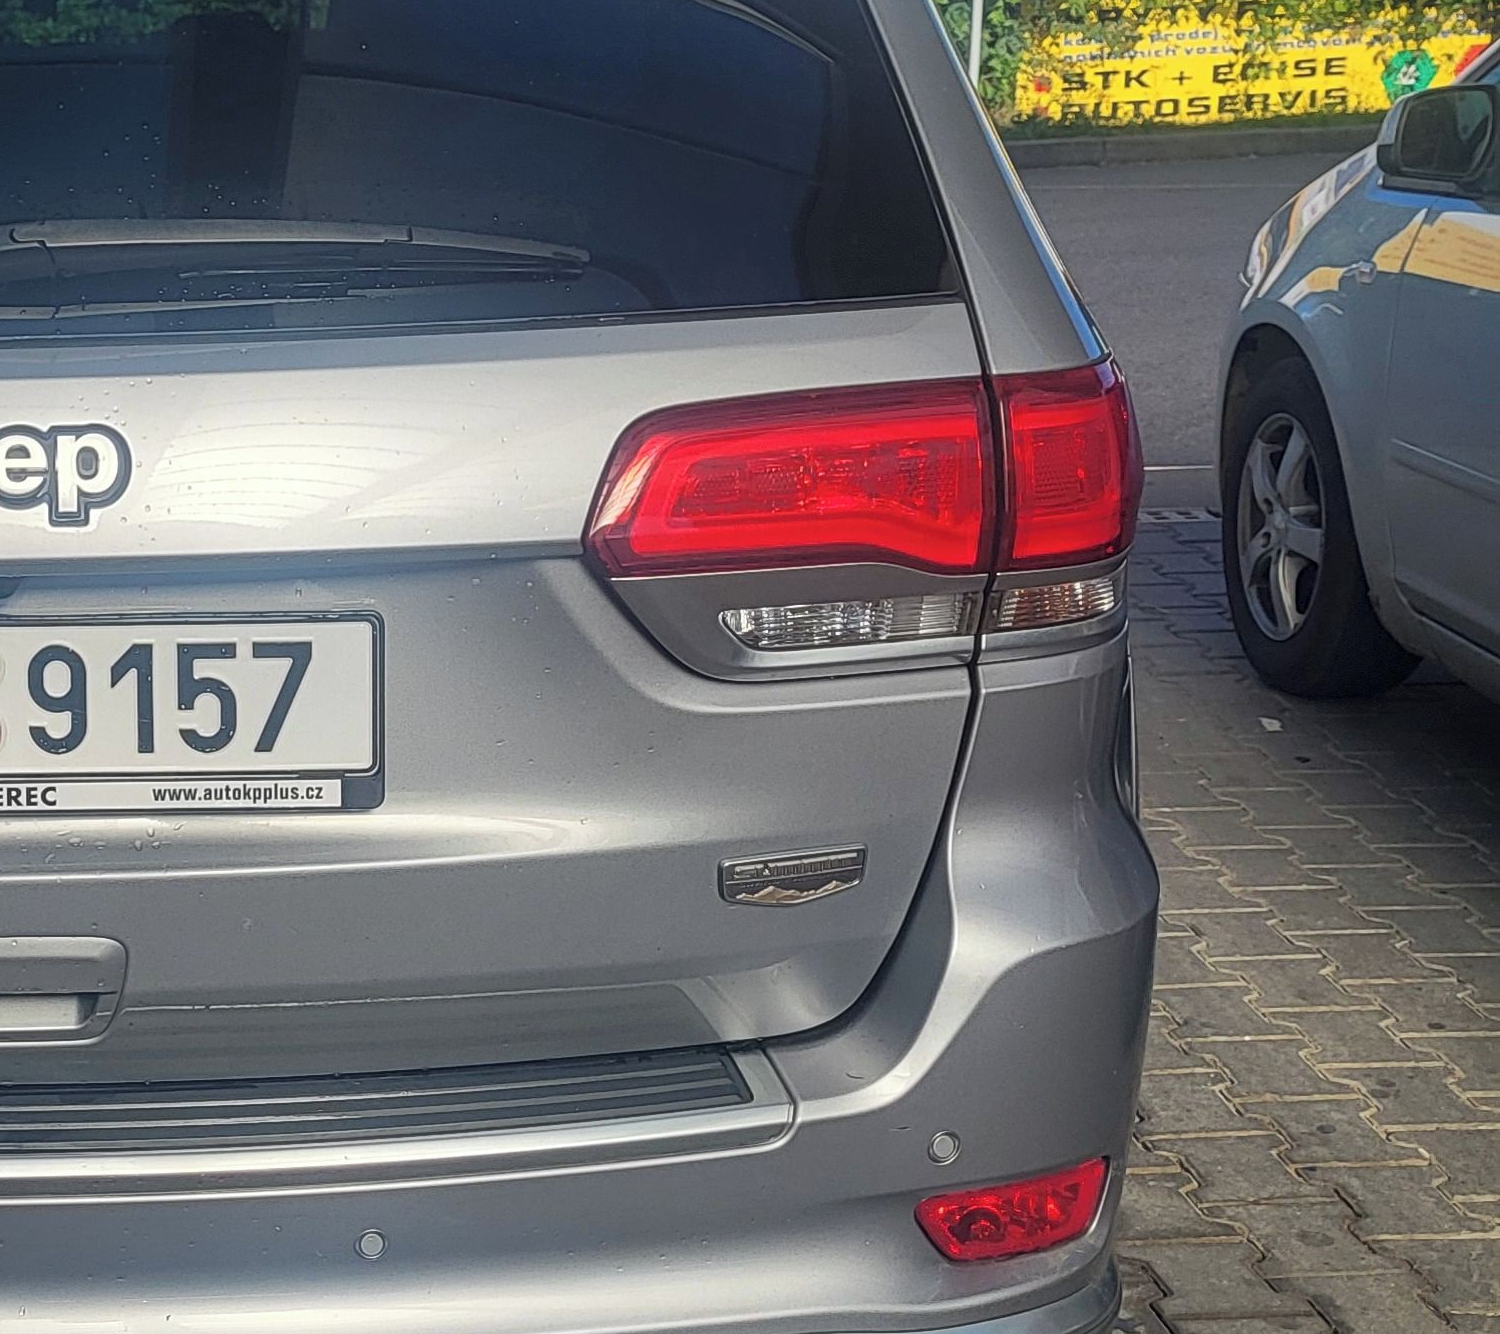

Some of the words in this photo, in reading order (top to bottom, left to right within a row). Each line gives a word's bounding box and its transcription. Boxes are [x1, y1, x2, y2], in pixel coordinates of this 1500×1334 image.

[1060, 69, 1151, 93] STK
[26, 641, 313, 755] 9157
[152, 781, 324, 805] www.autokpplus.cz
